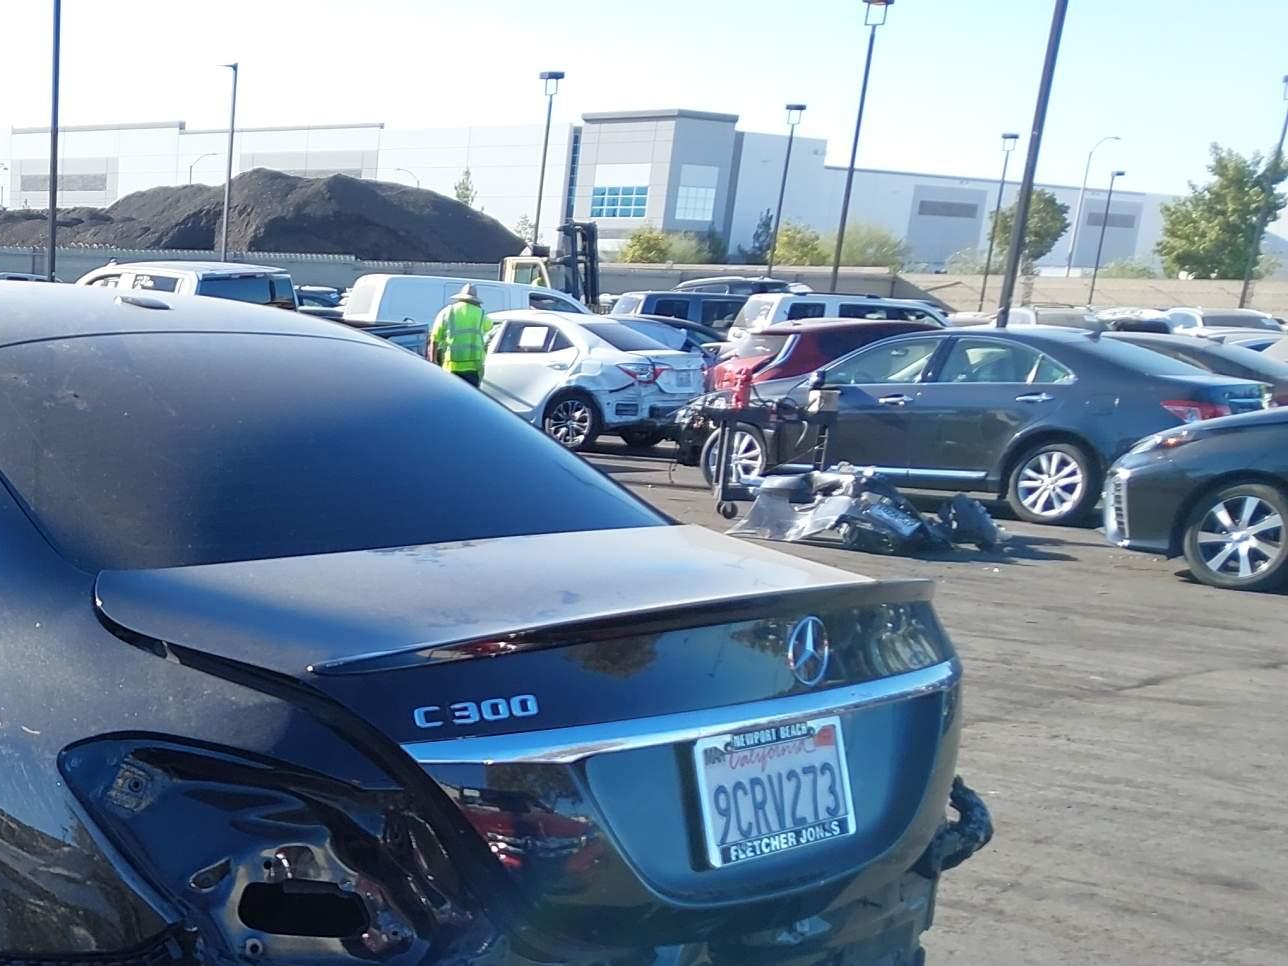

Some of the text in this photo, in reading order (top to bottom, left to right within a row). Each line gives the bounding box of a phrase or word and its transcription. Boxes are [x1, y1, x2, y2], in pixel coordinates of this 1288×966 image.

[414, 694, 539, 728] C 300
[733, 728, 777, 748] NEWPORT
[780, 723, 808, 739] BEACH
[713, 761, 841, 845] 9CRV273
[730, 820, 841, 861] FLETCHER JONES
